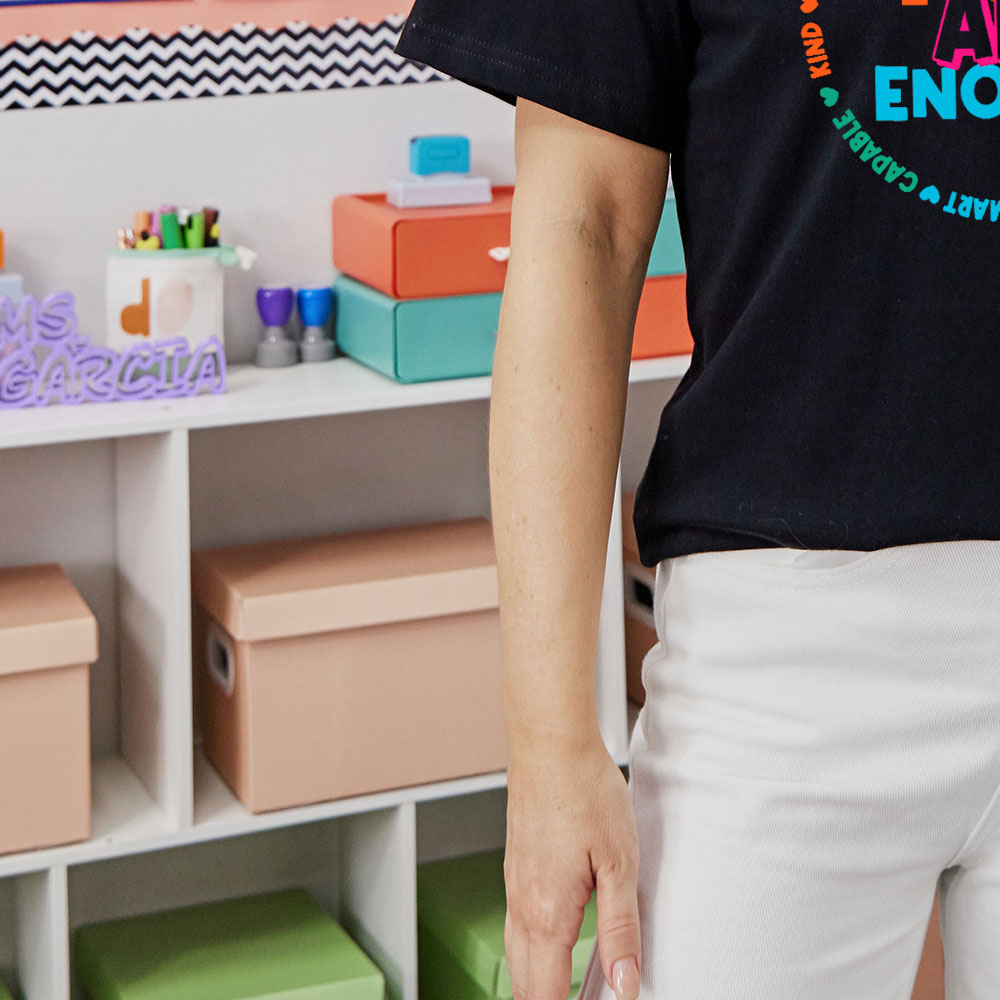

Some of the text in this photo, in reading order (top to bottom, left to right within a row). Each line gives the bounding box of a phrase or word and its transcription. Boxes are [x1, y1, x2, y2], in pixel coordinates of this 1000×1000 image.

[801, 22, 832, 79] KIND
[832, 109, 919, 192] CAPABLE
[0, 335, 227, 409] GARCIA
